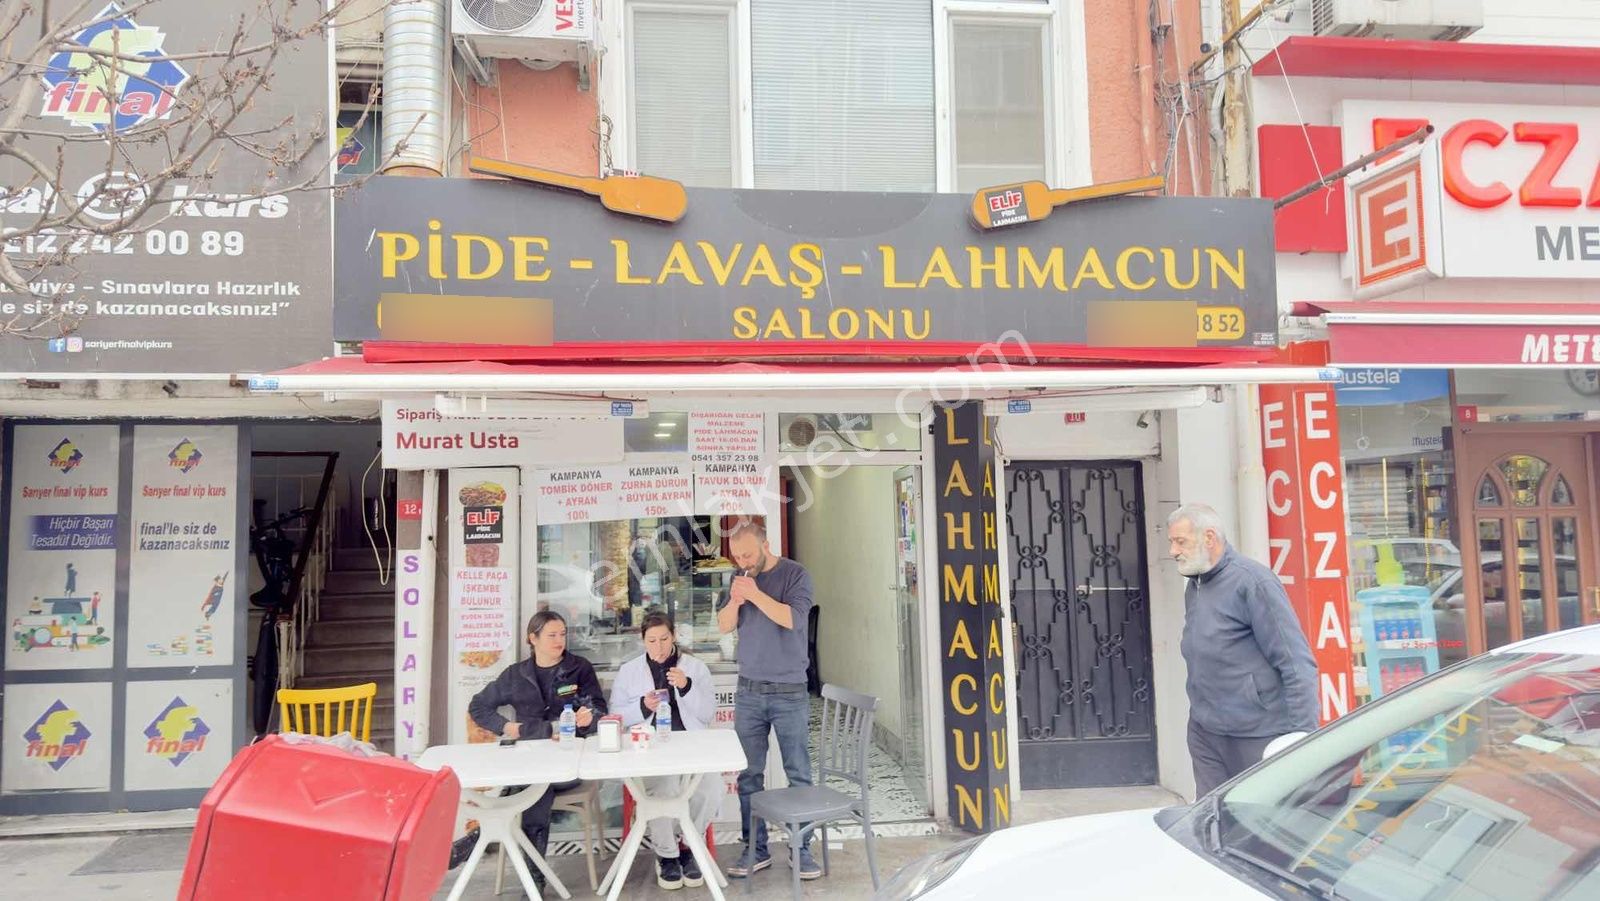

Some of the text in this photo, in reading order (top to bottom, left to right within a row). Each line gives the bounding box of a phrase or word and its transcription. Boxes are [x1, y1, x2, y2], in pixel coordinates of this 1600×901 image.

[46, 81, 176, 117] final
[170, 185, 288, 219] kurs
[146, 230, 189, 256] 00
[200, 230, 244, 256] 89
[376, 219, 551, 282] PİDE
[610, 239, 825, 299] LAVAŞ
[878, 245, 1246, 292] LAHMACUN
[102, 280, 210, 296] Sınavlara
[218, 281, 301, 296] Hazırlık
[732, 306, 933, 341] SALONU
[1218, 314, 1239, 332] 52
[396, 432, 519, 449] Murat Usta
[691, 454, 759, 462] 0541 357 23 98
[629, 466, 679, 477] KAMPANYA
[705, 463, 757, 473] KAMPANYA
[550, 470, 602, 482] KAMPANYA
[698, 477, 729, 486] TAVUK
[53, 485, 72, 497] final
[73, 485, 87, 499] vip
[88, 484, 108, 497] kurs
[173, 484, 191, 496] final
[192, 484, 206, 499] vip
[207, 483, 227, 496] kurs
[620, 479, 653, 490] ZURNA
[565, 496, 598, 506] AYRAN
[662, 491, 692, 501] AYRAN
[404, 503, 417, 515] 12
[50, 516, 113, 531] Hiçbir Başarı
[183, 522, 202, 535] siz
[203, 521, 217, 535] de
[31, 533, 70, 547] Tesadüf
[139, 538, 230, 550] kazanacaksınız
[456, 571, 484, 580] KELLE
[460, 596, 502, 606] BULUNUR
[943, 408, 984, 831] LAHMACUN
[982, 416, 1010, 829] LAHMACUN
[26, 739, 88, 758] final
[146, 735, 205, 754] final
